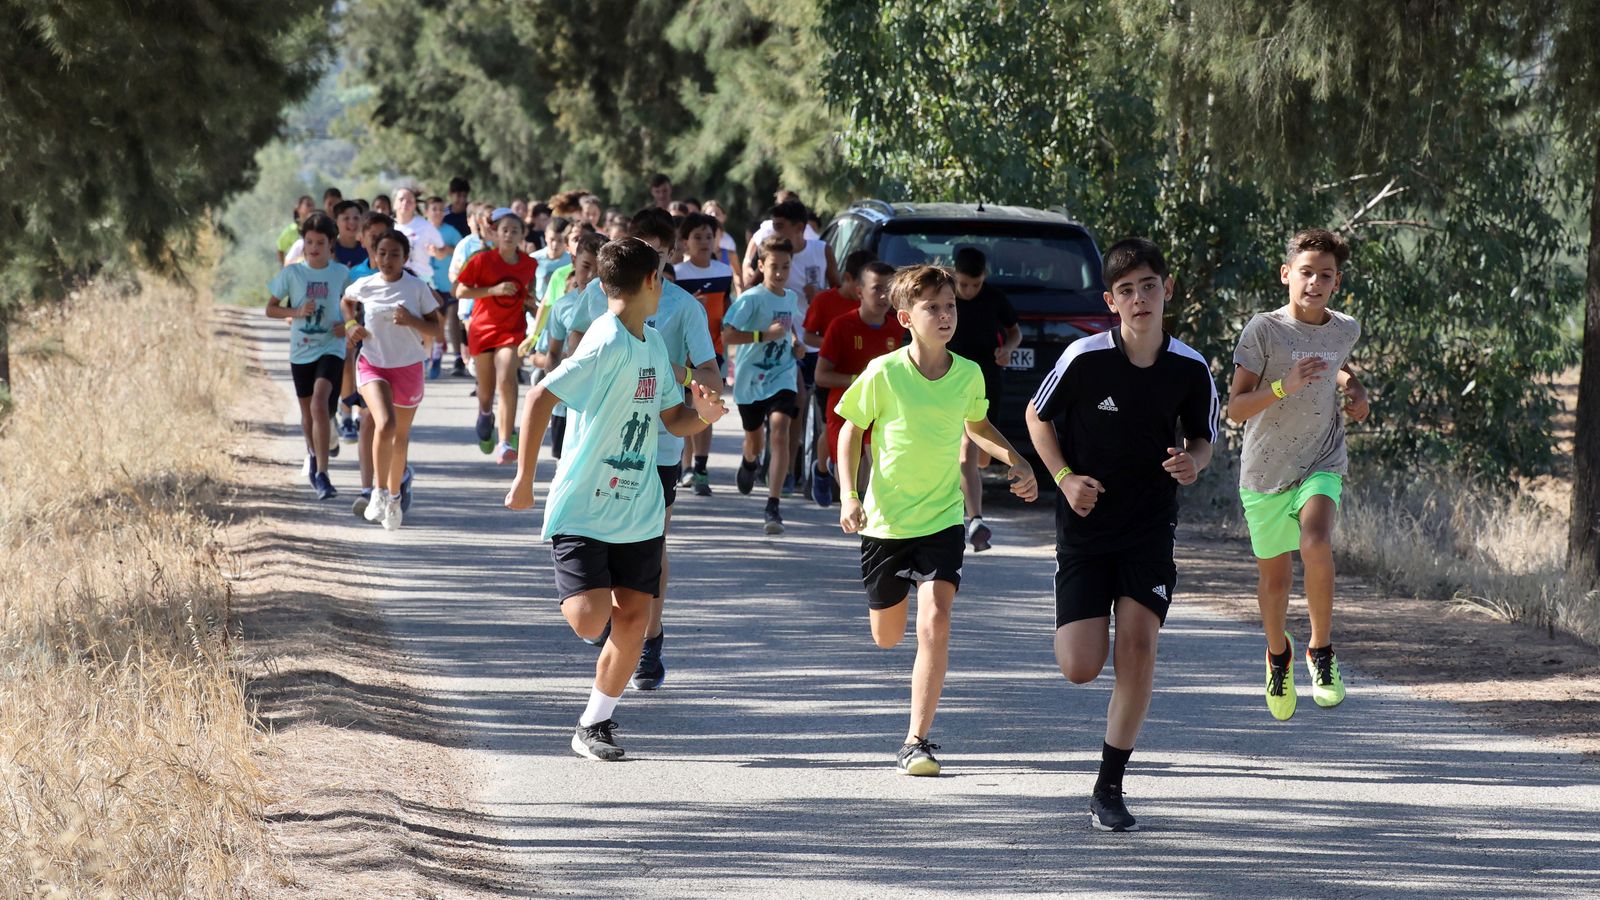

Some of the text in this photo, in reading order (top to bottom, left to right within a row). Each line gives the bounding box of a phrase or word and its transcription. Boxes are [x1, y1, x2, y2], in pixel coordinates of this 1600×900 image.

[854, 336, 863, 350] 10
[1010, 350, 1032, 366] RK
[1292, 351, 1301, 360] BE
[1097, 404, 1119, 412] adidas
[619, 478, 631, 486] 1000
